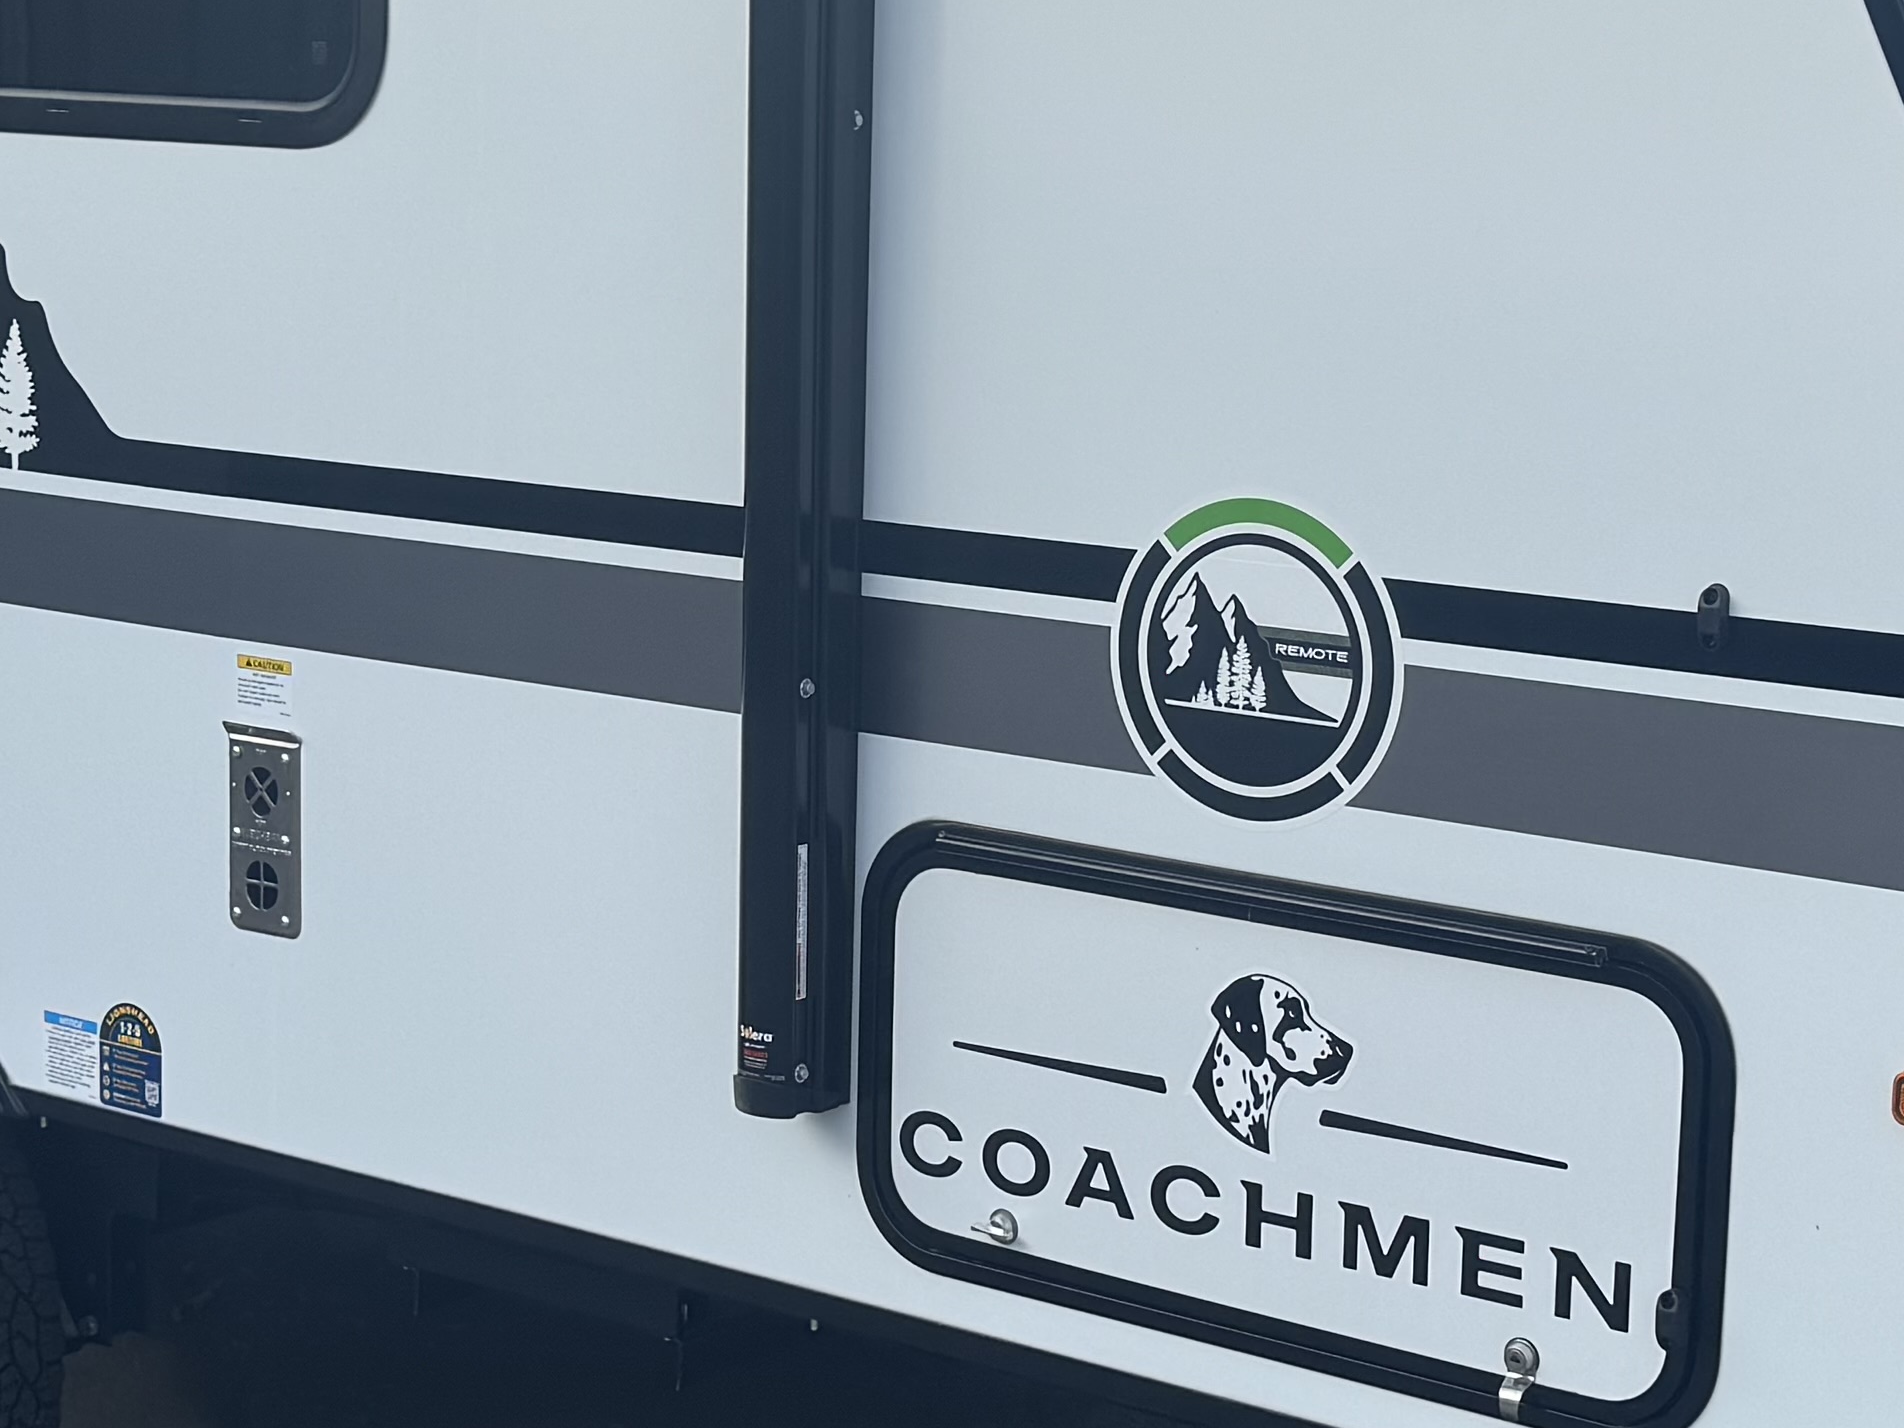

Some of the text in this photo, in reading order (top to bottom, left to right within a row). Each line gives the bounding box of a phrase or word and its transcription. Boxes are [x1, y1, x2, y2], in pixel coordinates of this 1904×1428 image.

[1275, 642, 1349, 664] REMOTE
[253, 659, 285, 672] CAUTION
[899, 1110, 1632, 1333] COACHMEN
